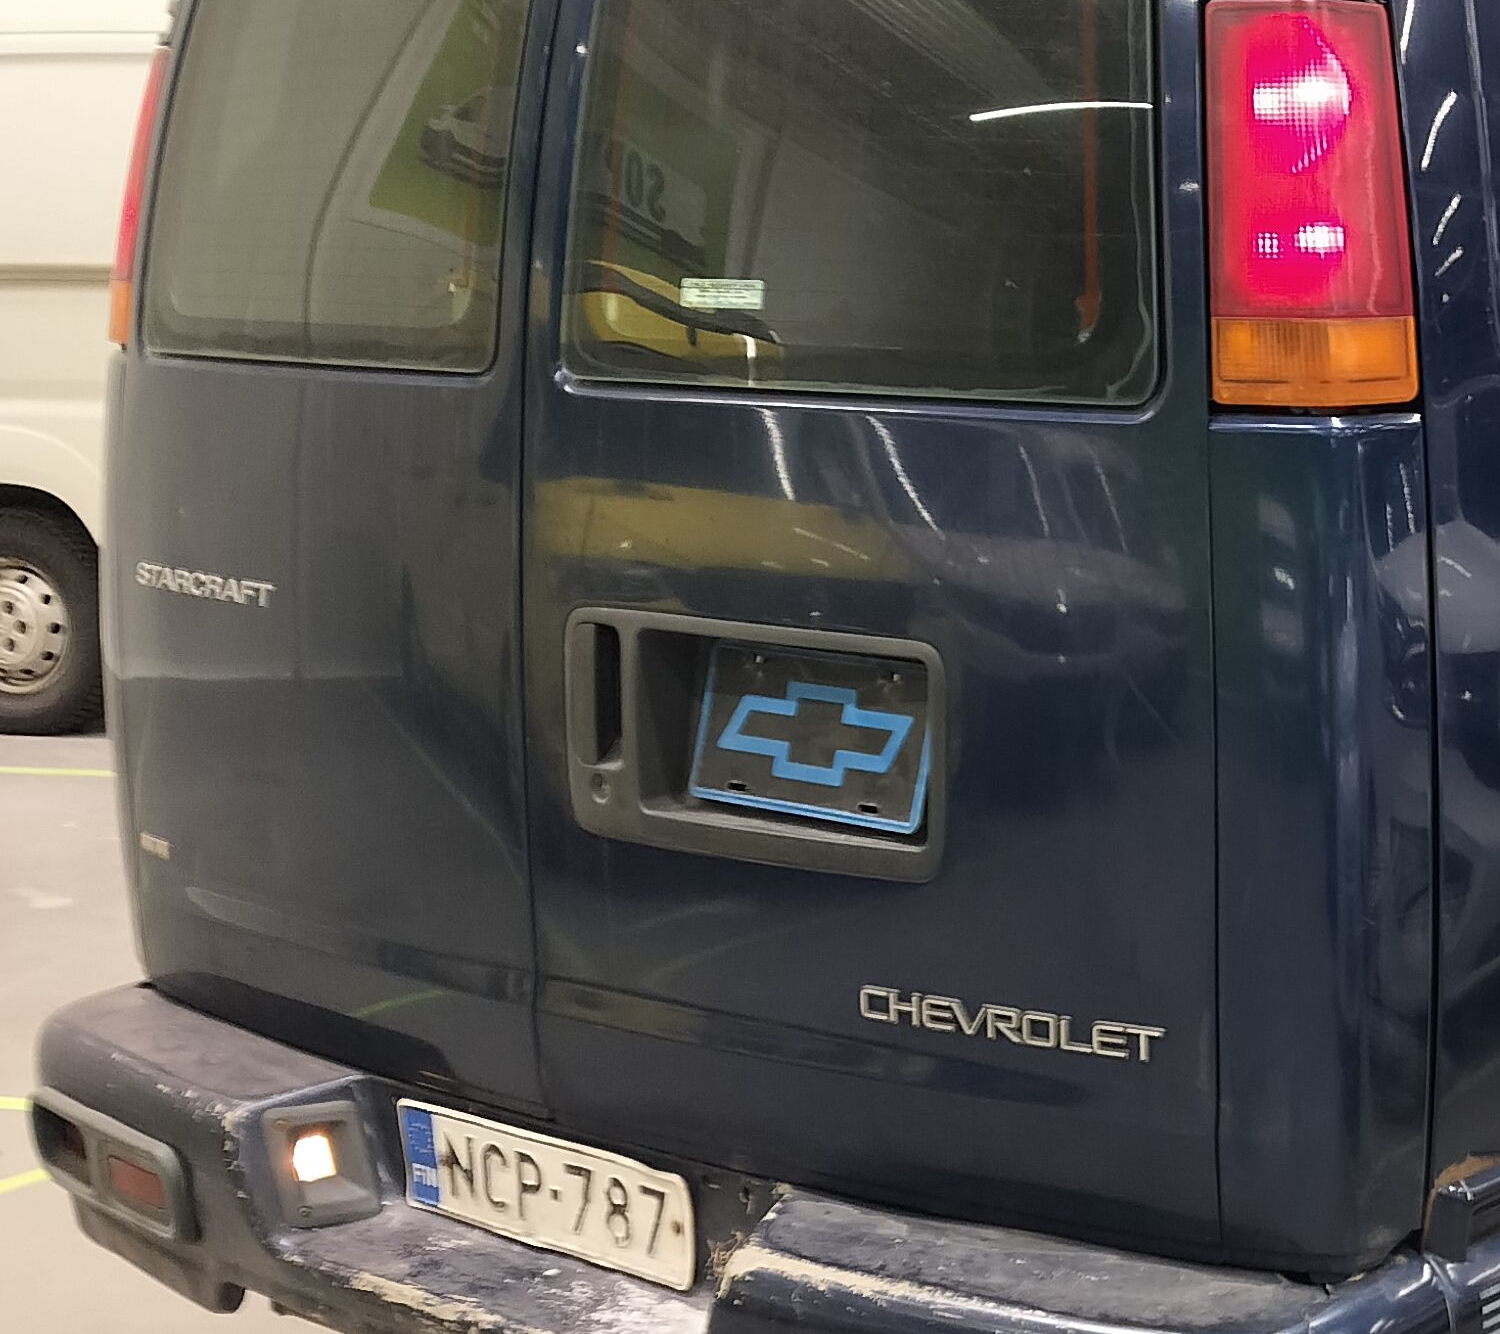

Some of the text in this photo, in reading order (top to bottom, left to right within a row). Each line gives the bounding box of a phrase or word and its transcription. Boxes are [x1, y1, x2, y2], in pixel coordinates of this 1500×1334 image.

[134, 560, 278, 608] STARCRAFT
[859, 984, 1167, 1063] CHEVROLET
[441, 1131, 666, 1259] NCP-787
